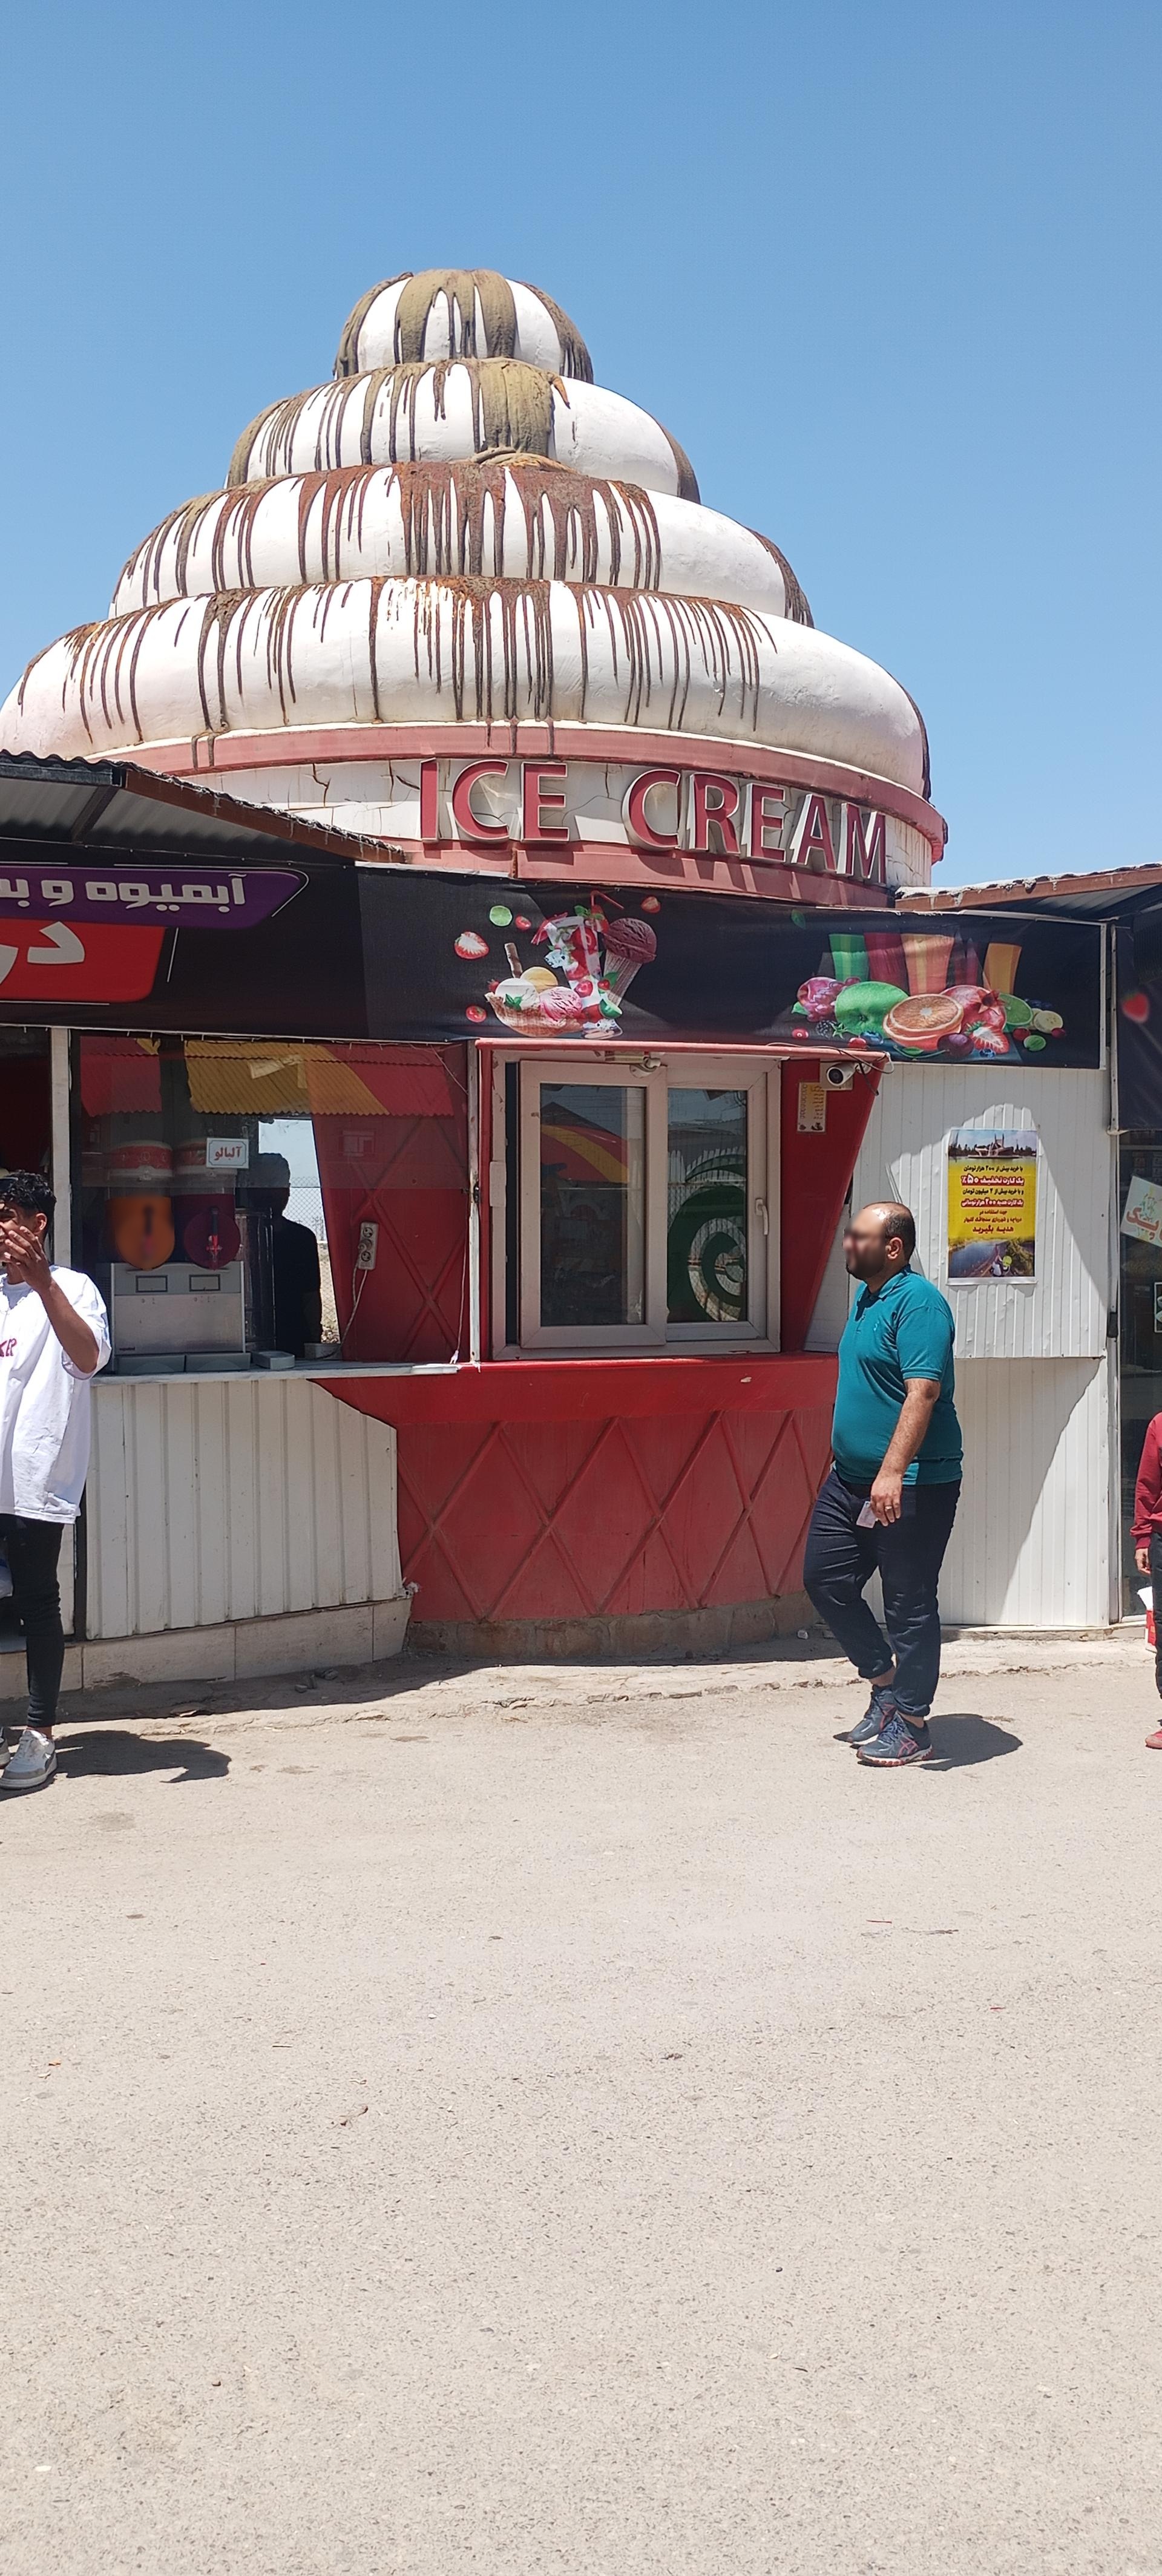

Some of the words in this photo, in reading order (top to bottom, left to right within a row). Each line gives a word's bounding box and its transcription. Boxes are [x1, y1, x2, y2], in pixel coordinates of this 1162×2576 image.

[419, 758, 570, 842] ICE
[622, 769, 887, 884] CREAM
[41, 879, 74, 906] و
[85, 873, 248, 913] آبمیوه
[214, 1145, 242, 1161] آلبالو
[980, 1177, 1002, 1185] تخفیف
[1016, 1177, 1024, 1185] یک
[973, 1224, 994, 1234] بگیرید
[996, 1225, 1014, 1234] هدیه
